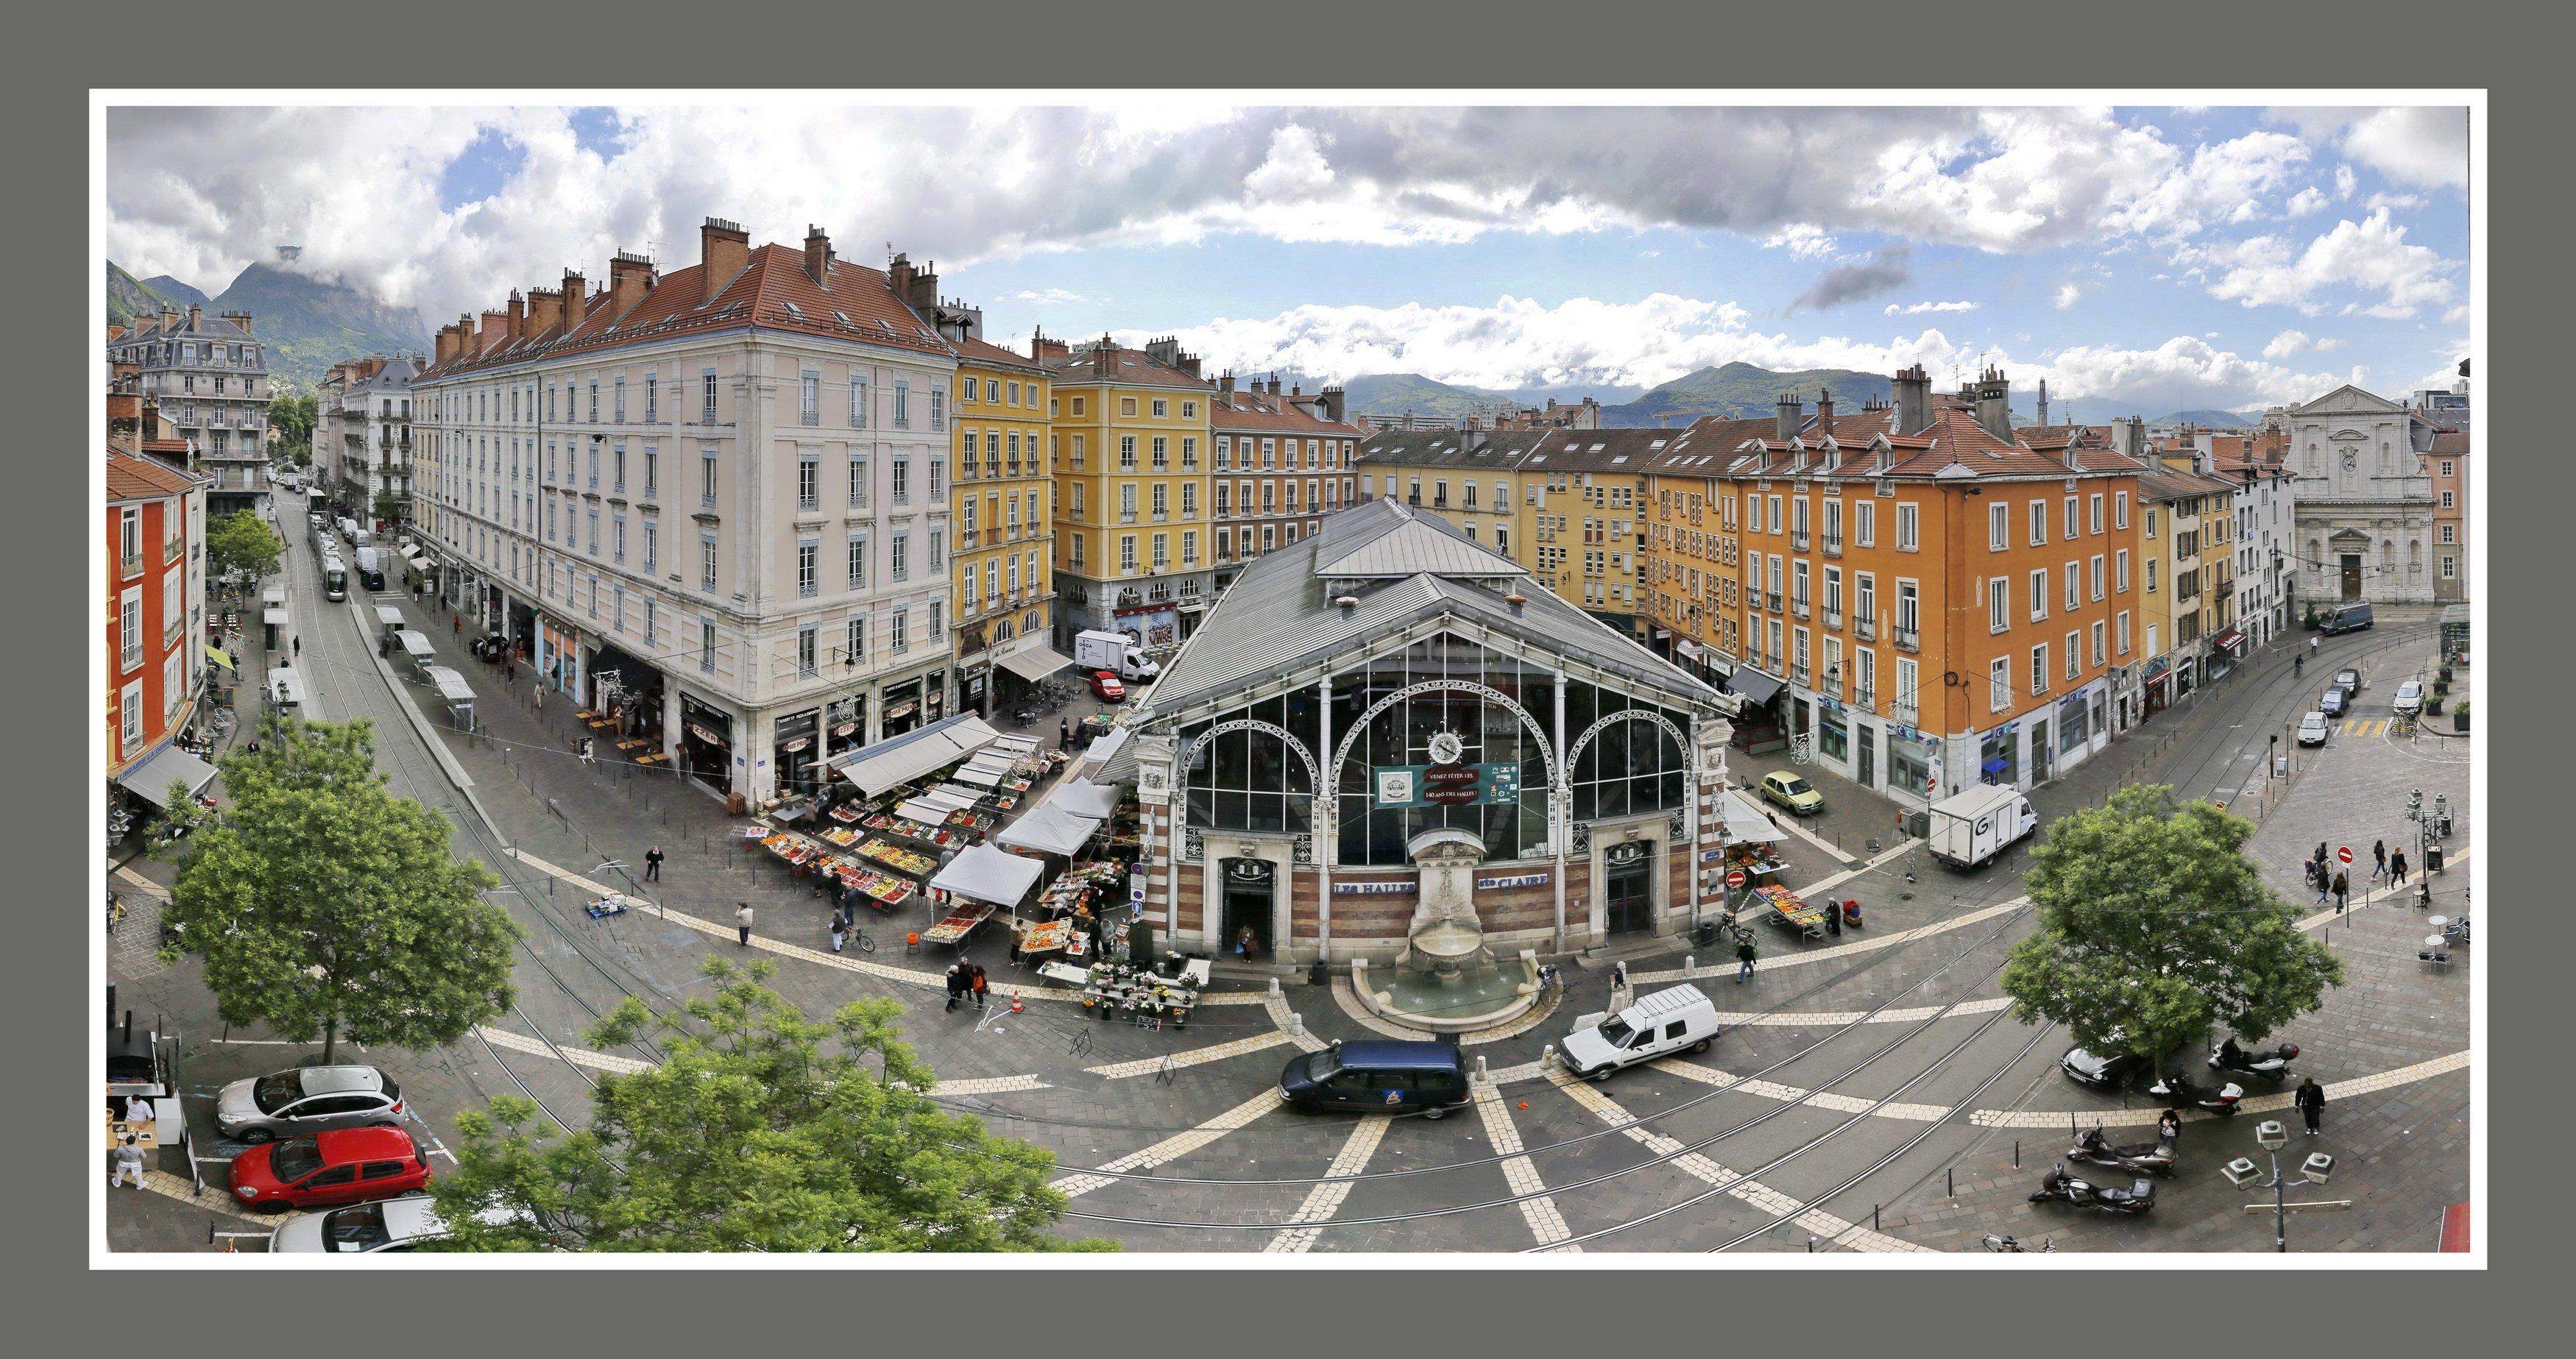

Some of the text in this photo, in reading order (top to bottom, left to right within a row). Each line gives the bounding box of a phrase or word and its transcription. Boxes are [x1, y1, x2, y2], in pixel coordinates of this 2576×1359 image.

[886, 708, 901, 717] COME
[119, 759, 146, 780] LIBRAIRIE
[147, 751, 155, 760] LA
[1498, 875, 1547, 889] CLAIRE
[1334, 883, 1415, 894] LES HALLES
